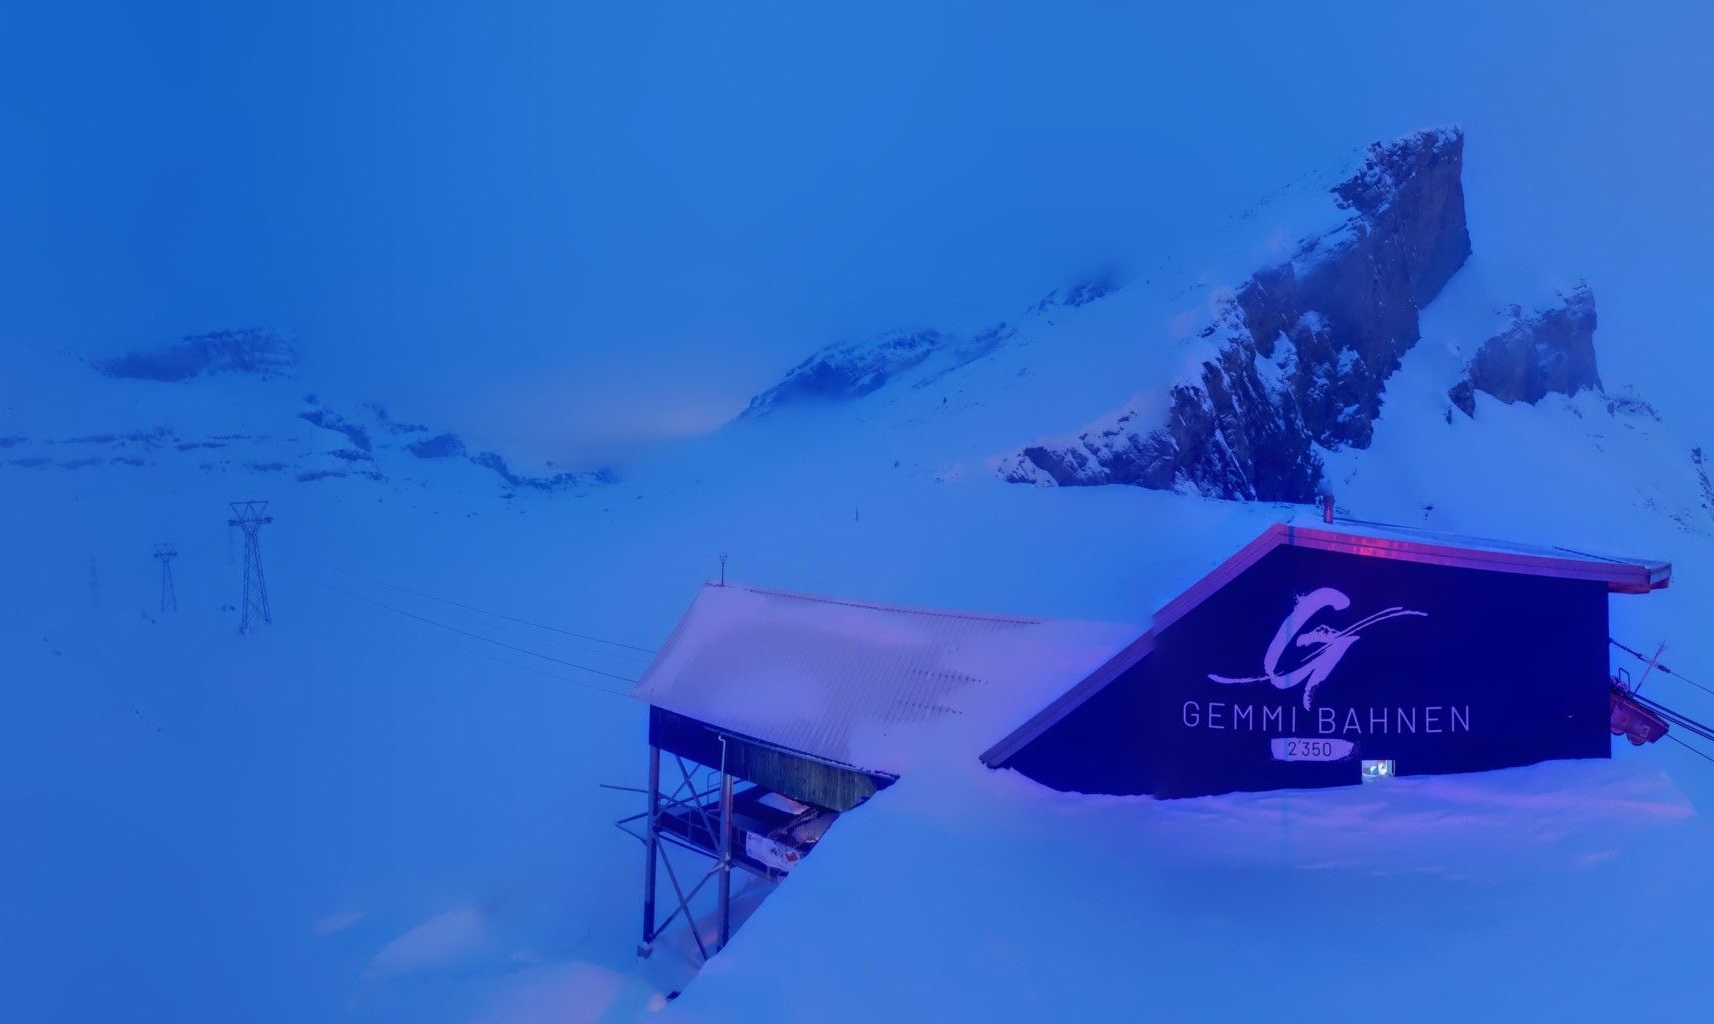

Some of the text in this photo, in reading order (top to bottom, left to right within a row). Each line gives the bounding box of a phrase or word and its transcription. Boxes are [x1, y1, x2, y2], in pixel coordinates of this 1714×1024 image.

[1182, 700, 1471, 734] GEMMI BAHNEN
[1287, 740, 1333, 757] 2'350
